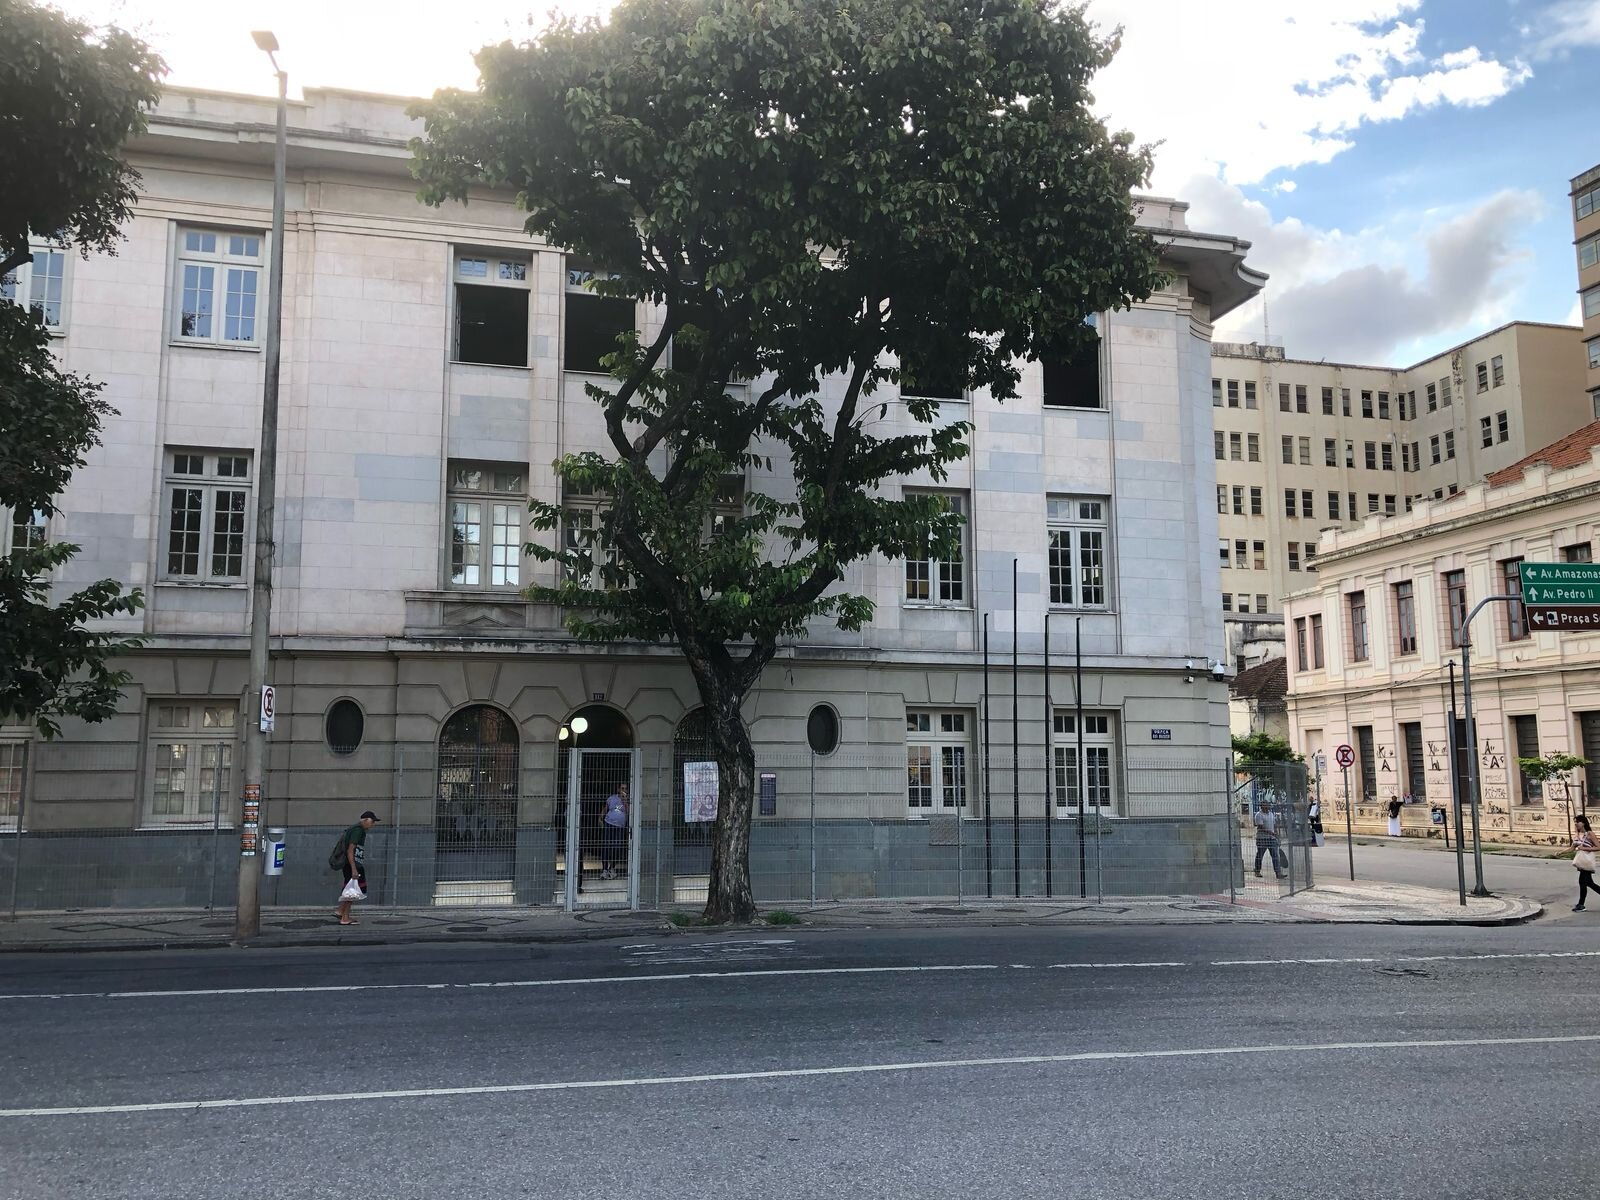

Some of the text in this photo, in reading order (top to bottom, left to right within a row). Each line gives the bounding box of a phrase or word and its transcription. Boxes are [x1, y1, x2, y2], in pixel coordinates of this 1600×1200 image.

[1541, 569, 1553, 578] Av.
[1543, 589, 1594, 599] Av. Pedro II
[1561, 613, 1590, 624] Praça
